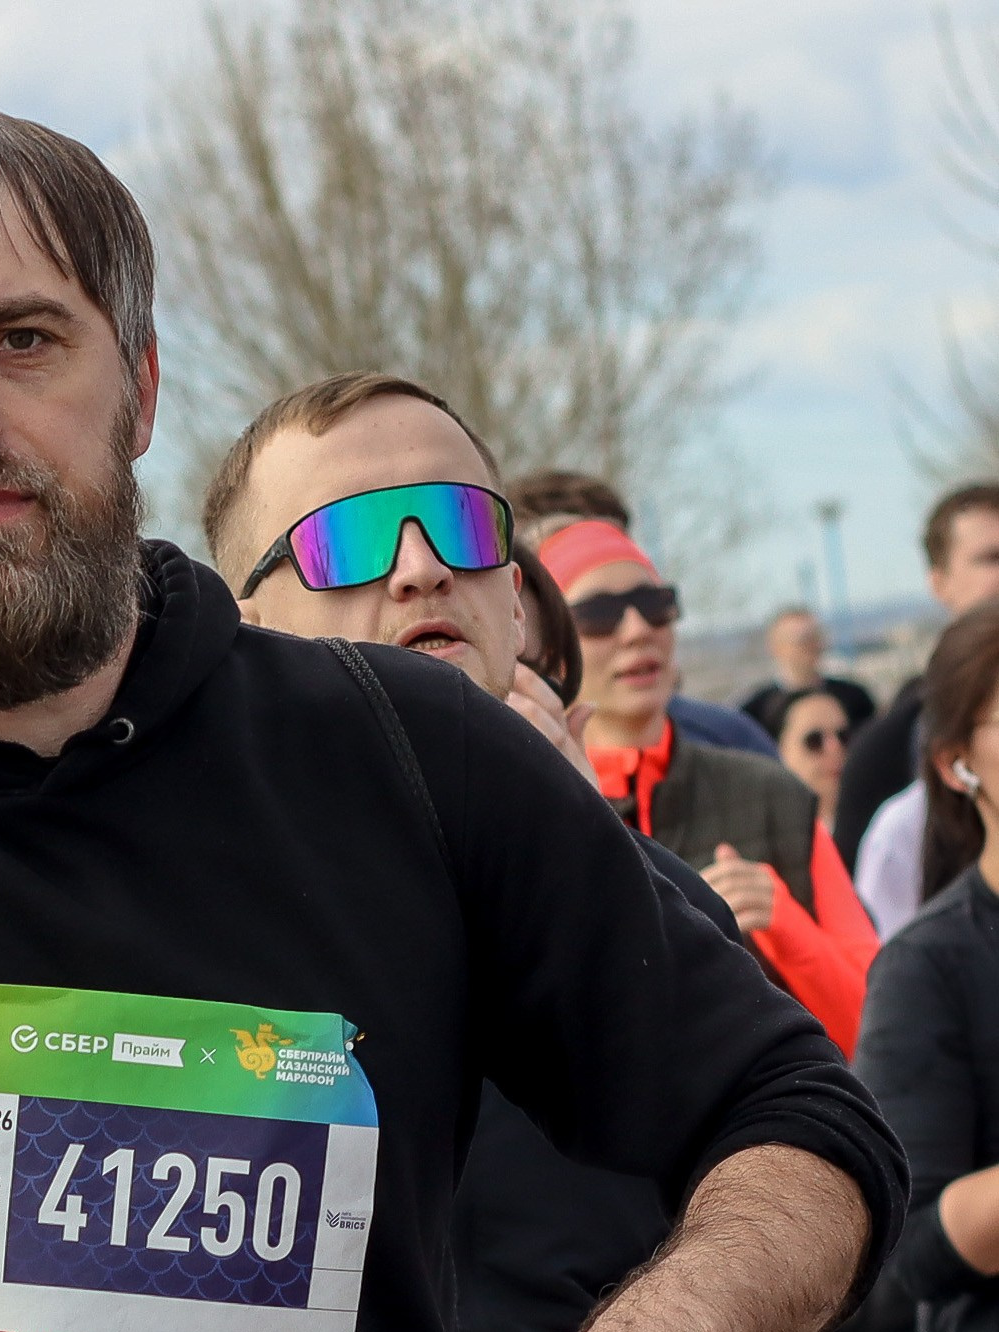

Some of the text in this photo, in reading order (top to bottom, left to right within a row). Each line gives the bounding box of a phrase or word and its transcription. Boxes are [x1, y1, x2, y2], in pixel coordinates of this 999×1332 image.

[44, 1032, 171, 1059] СБЕР Прайм
[278, 1049, 346, 1064] СБЕРПРАЙМ
[276, 1060, 350, 1076] КАЗАНСКИЙ
[275, 1071, 335, 1086] МАРАФОН
[37, 1143, 302, 1262] 41250
[339, 1220, 366, 1230] BRICS
